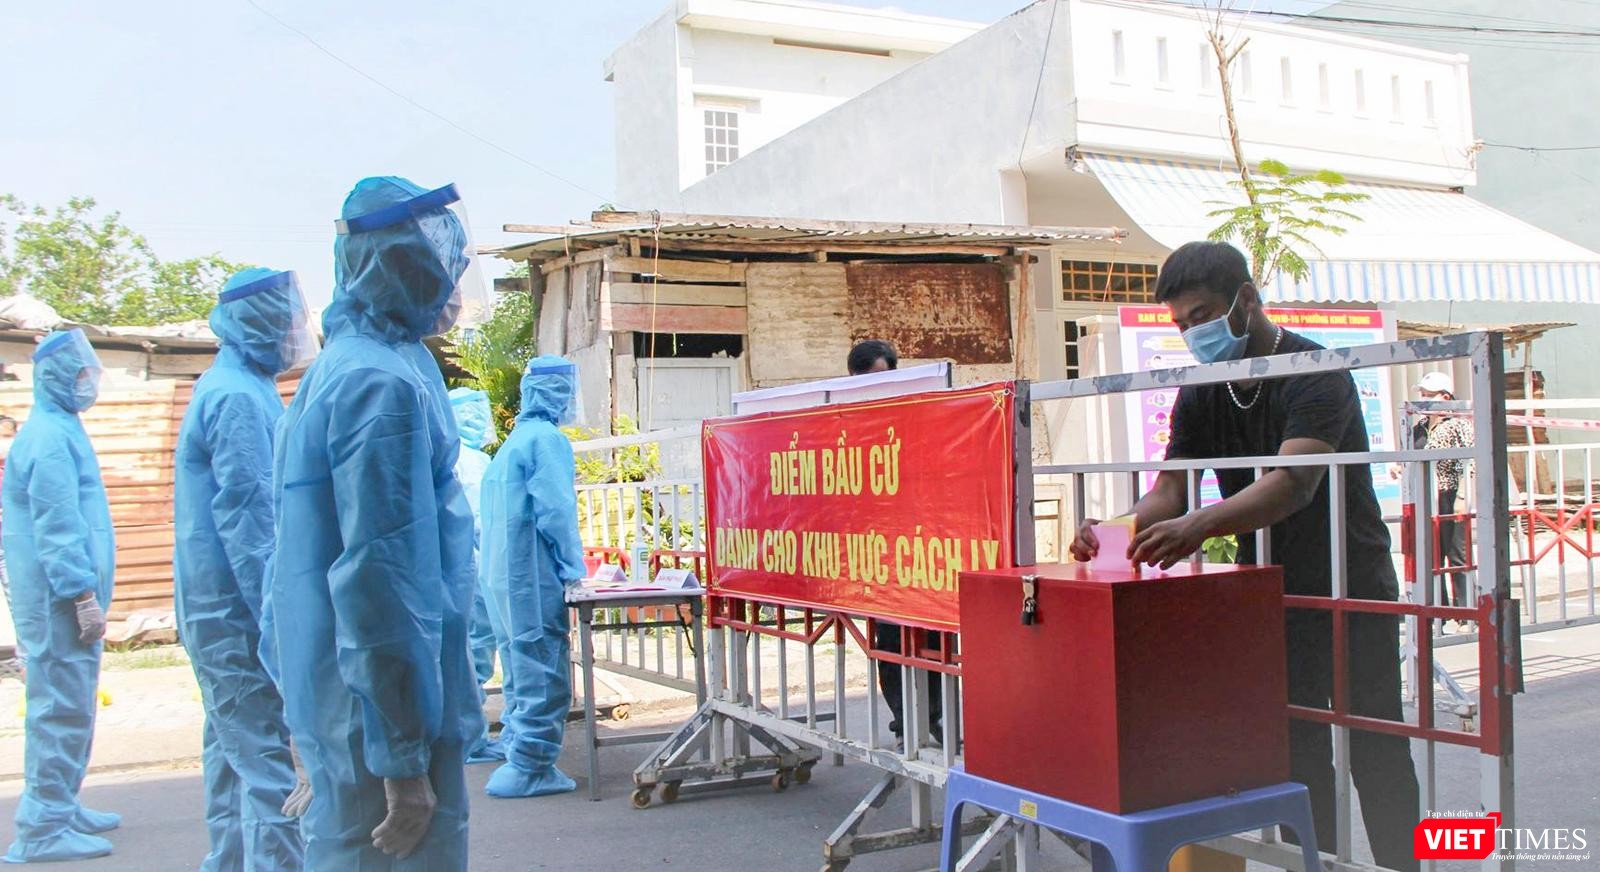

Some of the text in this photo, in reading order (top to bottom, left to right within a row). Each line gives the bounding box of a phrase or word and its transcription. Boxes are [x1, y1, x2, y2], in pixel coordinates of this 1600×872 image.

[1138, 313, 1156, 322] BAN
[1348, 315, 1370, 325] TRUNG
[770, 426, 901, 496] ĐIỂM BẦU CỬ
[716, 519, 758, 570] DÀNH
[762, 529, 797, 575] CHO
[802, 531, 840, 579] KHU
[845, 529, 889, 594] VỰC
[895, 525, 962, 592] CÁCH
